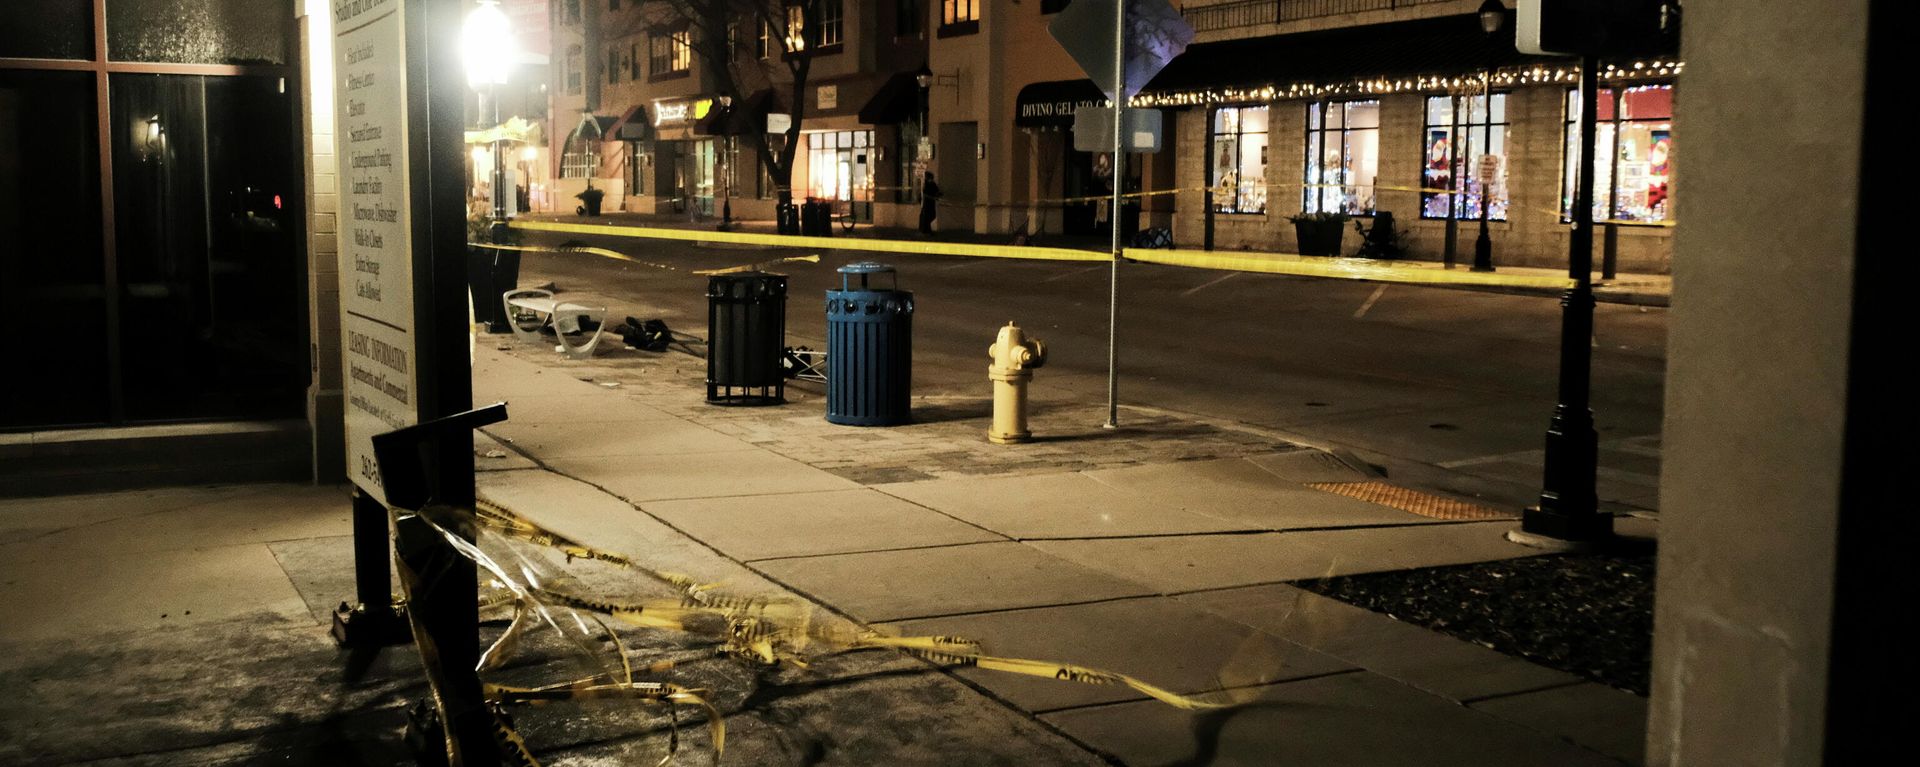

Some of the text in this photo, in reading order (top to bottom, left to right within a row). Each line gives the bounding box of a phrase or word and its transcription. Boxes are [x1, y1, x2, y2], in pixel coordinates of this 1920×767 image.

[348, 72, 362, 90] Fitness
[349, 98, 366, 117] Elevator
[1022, 102, 1053, 117] DIVINO
[350, 122, 381, 143] Secured Entrance
[351, 147, 392, 174] Underground Parking
[352, 176, 382, 200] Laundry Facility
[353, 203, 397, 223] Microwave, Dishwasher
[370, 230, 383, 249] Closets
[355, 253, 380, 281] Extra Storage
[365, 282, 381, 302] Allowed
[348, 330, 407, 375] LEASING INFORMATION
[350, 361, 408, 406] Apartments and Commercial
